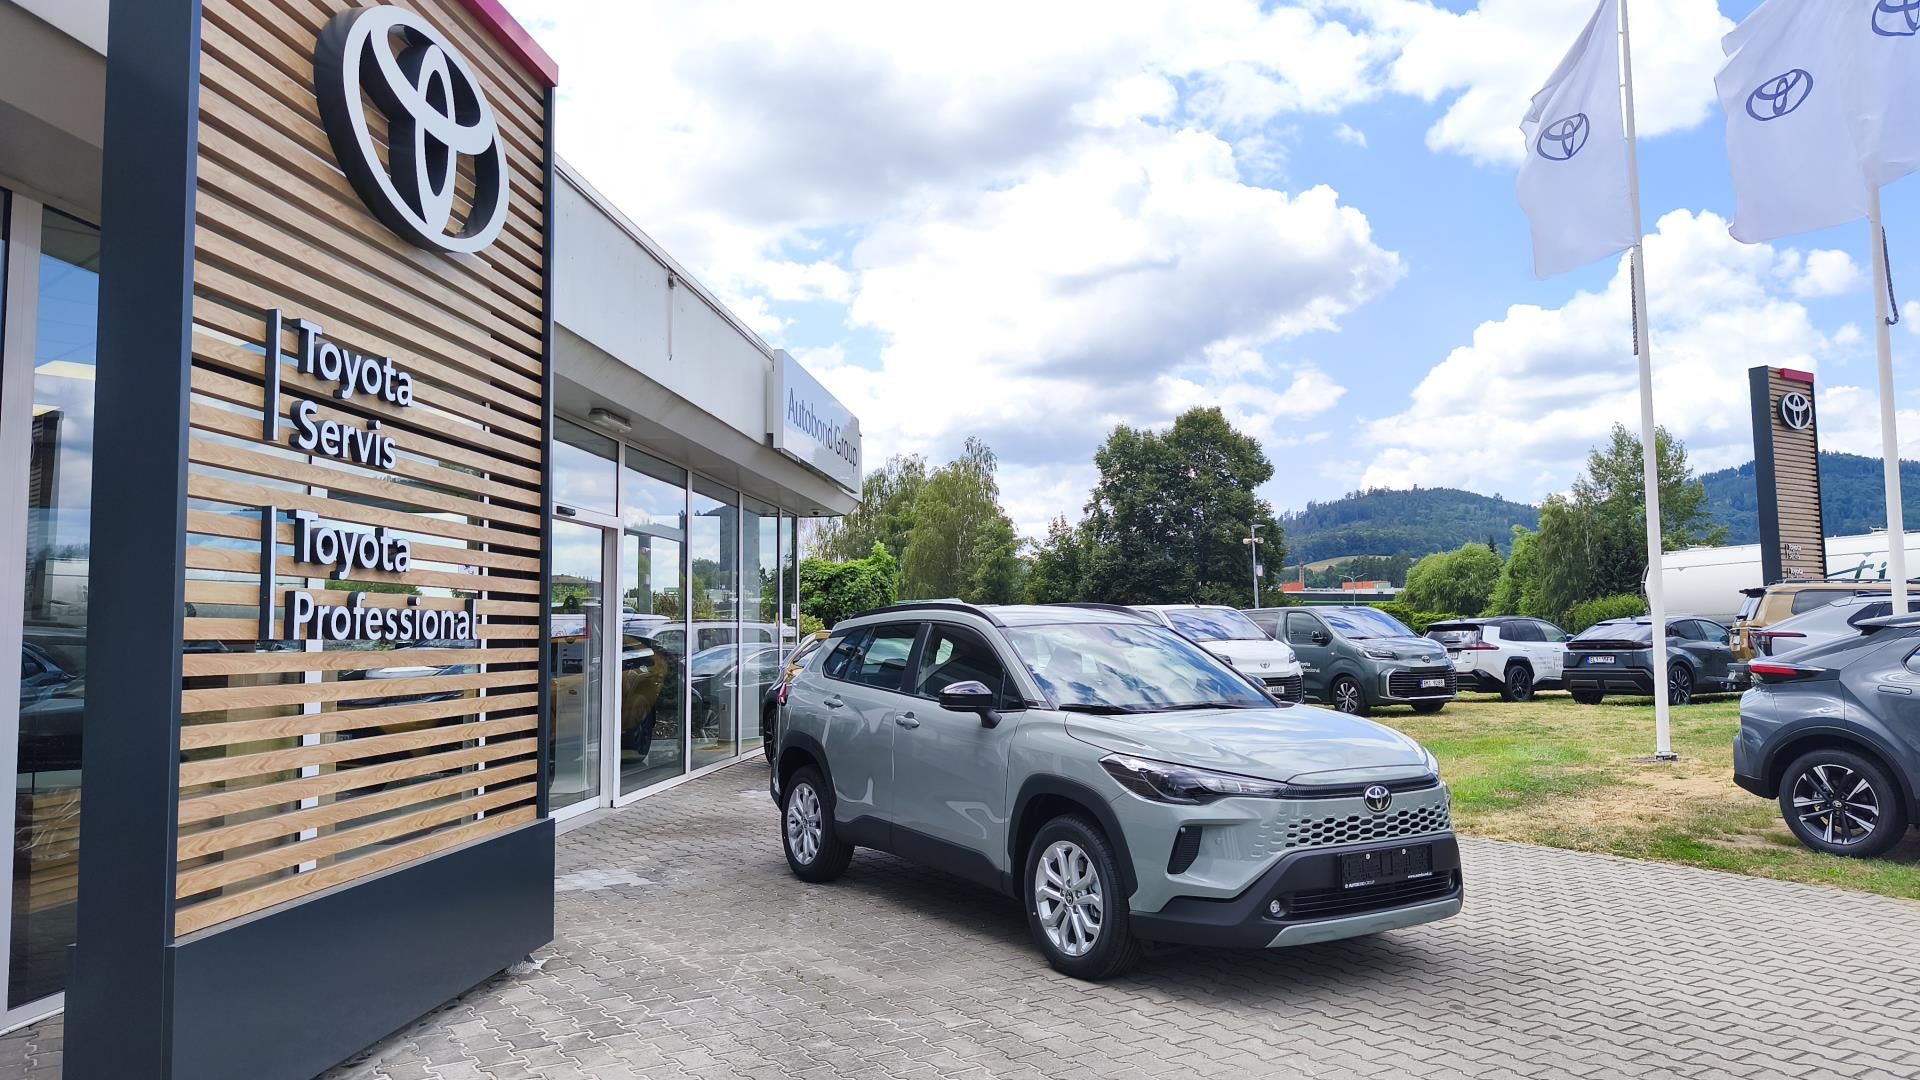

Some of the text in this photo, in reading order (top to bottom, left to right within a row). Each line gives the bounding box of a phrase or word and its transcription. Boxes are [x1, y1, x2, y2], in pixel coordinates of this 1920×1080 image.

[299, 318, 414, 408] Toyota
[296, 400, 398, 470] Servis
[788, 387, 858, 473] Autobond Group
[295, 509, 412, 580] Toyota
[293, 590, 479, 641] Professional
